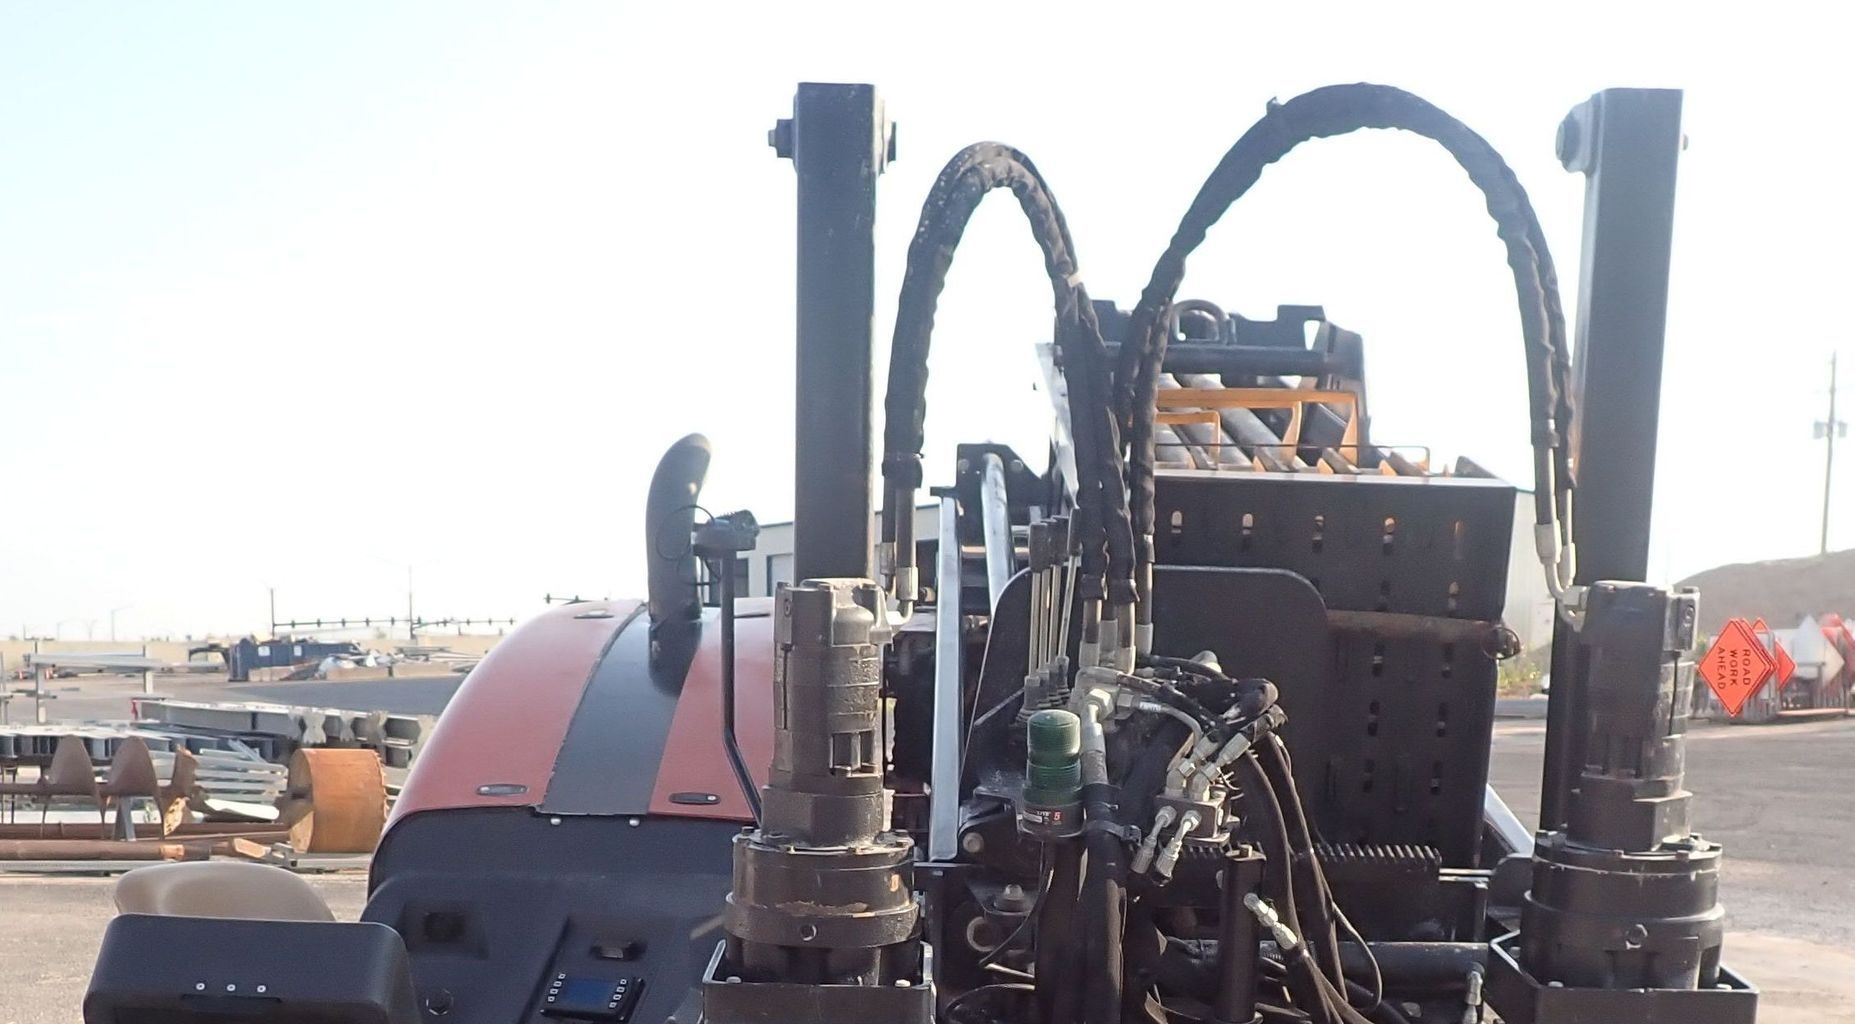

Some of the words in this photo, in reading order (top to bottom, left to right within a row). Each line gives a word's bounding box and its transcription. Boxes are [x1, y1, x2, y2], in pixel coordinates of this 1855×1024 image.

[1717, 646, 1726, 690] AHEAD
[1729, 649, 1738, 686] WORK
[1742, 649, 1751, 686] ROAD
